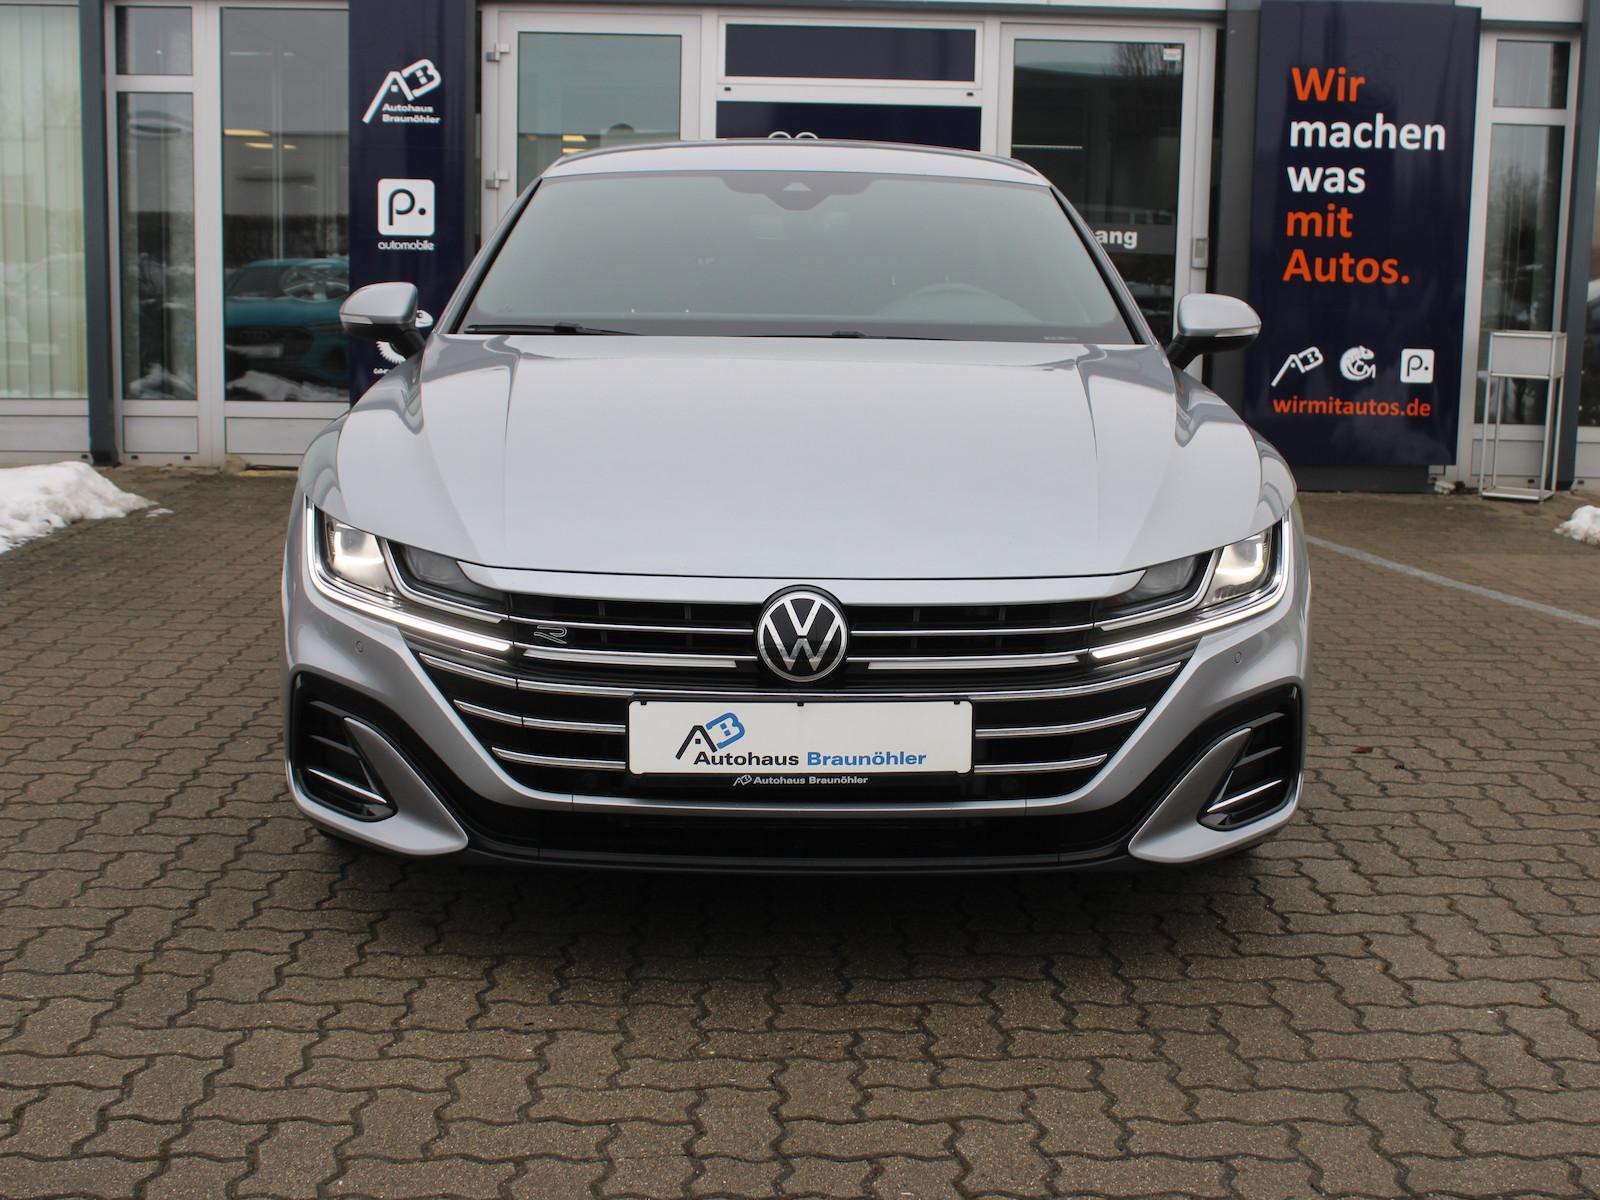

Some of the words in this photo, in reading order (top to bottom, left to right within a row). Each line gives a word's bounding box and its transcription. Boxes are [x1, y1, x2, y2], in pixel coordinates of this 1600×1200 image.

[1291, 66, 1366, 102] Wir
[382, 103, 434, 113] Autohaus
[382, 113, 441, 124] Braunöhler
[1289, 112, 1447, 151] machen
[1286, 165, 1367, 194] was
[1285, 202, 1354, 238] mit
[377, 240, 435, 251] automobile
[1281, 248, 1411, 285] Autos.
[1272, 395, 1431, 417] wirmitautos.de
[693, 750, 799, 767] Autohaus
[806, 750, 927, 767] Braunöhler
[753, 776, 806, 785] Autohaus
[808, 776, 868, 785] Braunöhler
